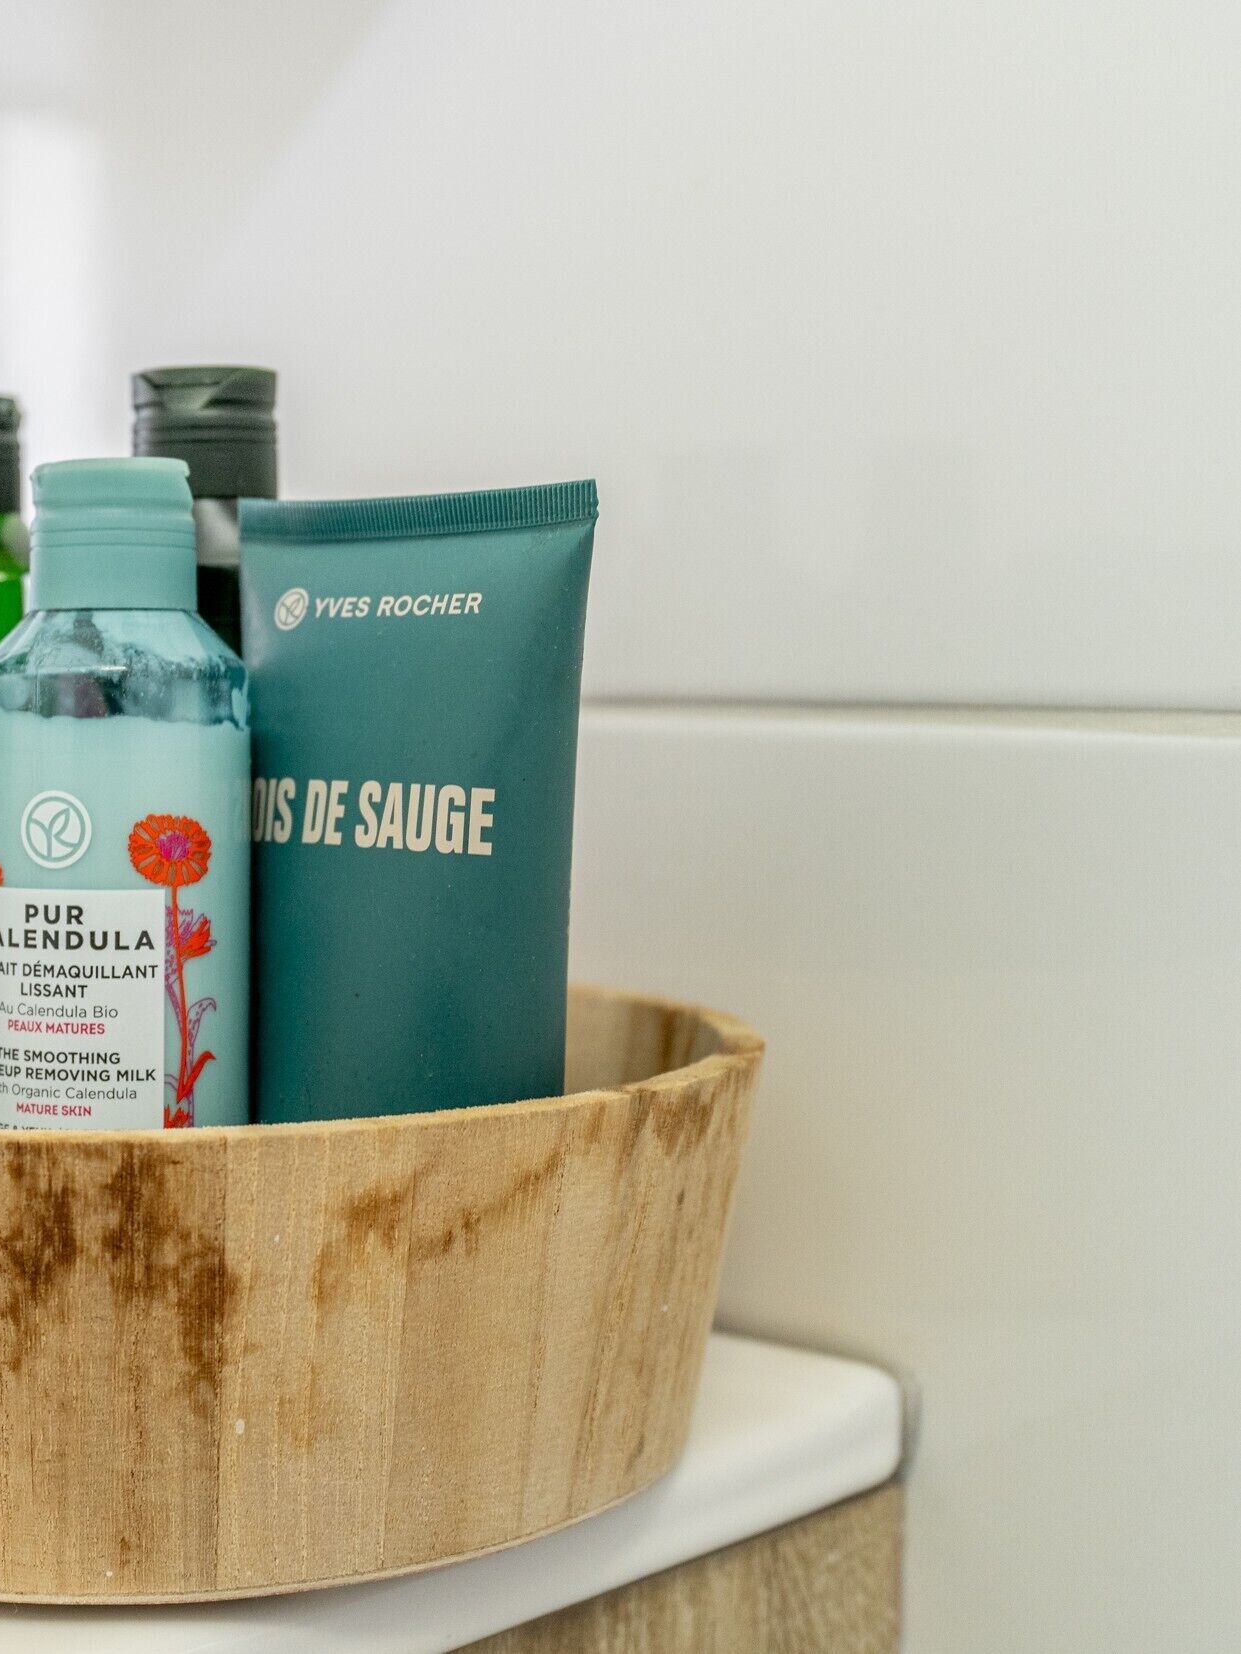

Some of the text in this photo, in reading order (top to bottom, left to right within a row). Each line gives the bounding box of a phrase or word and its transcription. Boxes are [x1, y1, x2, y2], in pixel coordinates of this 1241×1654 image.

[314, 592, 482, 618] YVES ROCHER
[252, 777, 496, 856] OIS DE SAUGE
[24, 903, 84, 925] PUR
[22, 960, 159, 980] DÉMAQUILLANT
[20, 982, 88, 999] LISSANT
[17, 1003, 88, 1019] Calendula
[92, 1006, 119, 1019] Bio
[7, 1019, 106, 1035] PEAUX MATURES
[23, 1050, 121, 1064] SMOOTHING
[25, 1067, 111, 1082] REMOVING
[116, 1069, 157, 1082] MILK
[11, 1083, 61, 1100] Organic
[65, 1087, 138, 1100] Calendula
[16, 1102, 92, 1116] MATURE SKIN
